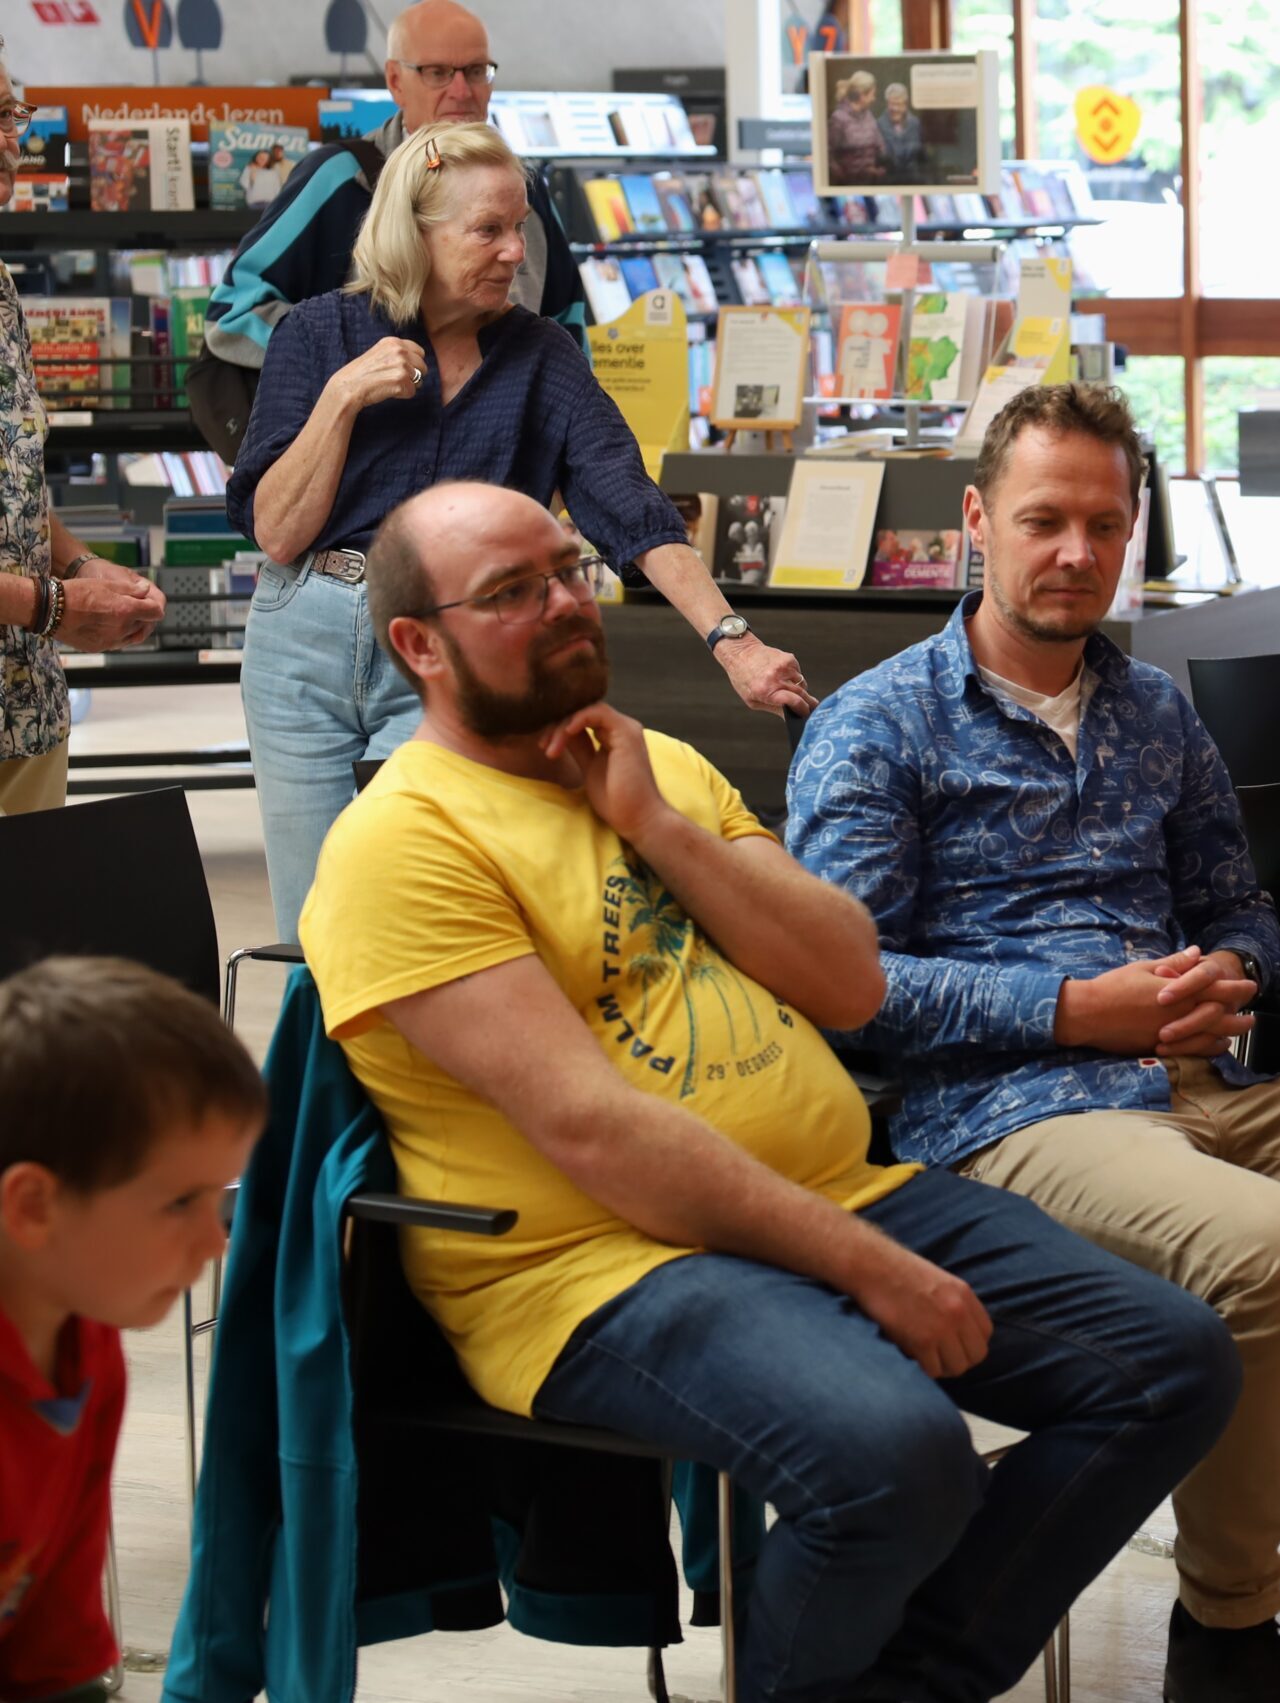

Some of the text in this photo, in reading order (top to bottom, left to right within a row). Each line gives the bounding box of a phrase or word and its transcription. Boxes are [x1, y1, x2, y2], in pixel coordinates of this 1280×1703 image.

[82, 103, 284, 125] Nederlands lezen
[219, 126, 308, 151] Samen
[616, 344, 645, 353] over
[593, 355, 645, 369] ementie
[596, 875, 676, 1075] PALM TREES
[736, 1041, 783, 1078] DEGREES
